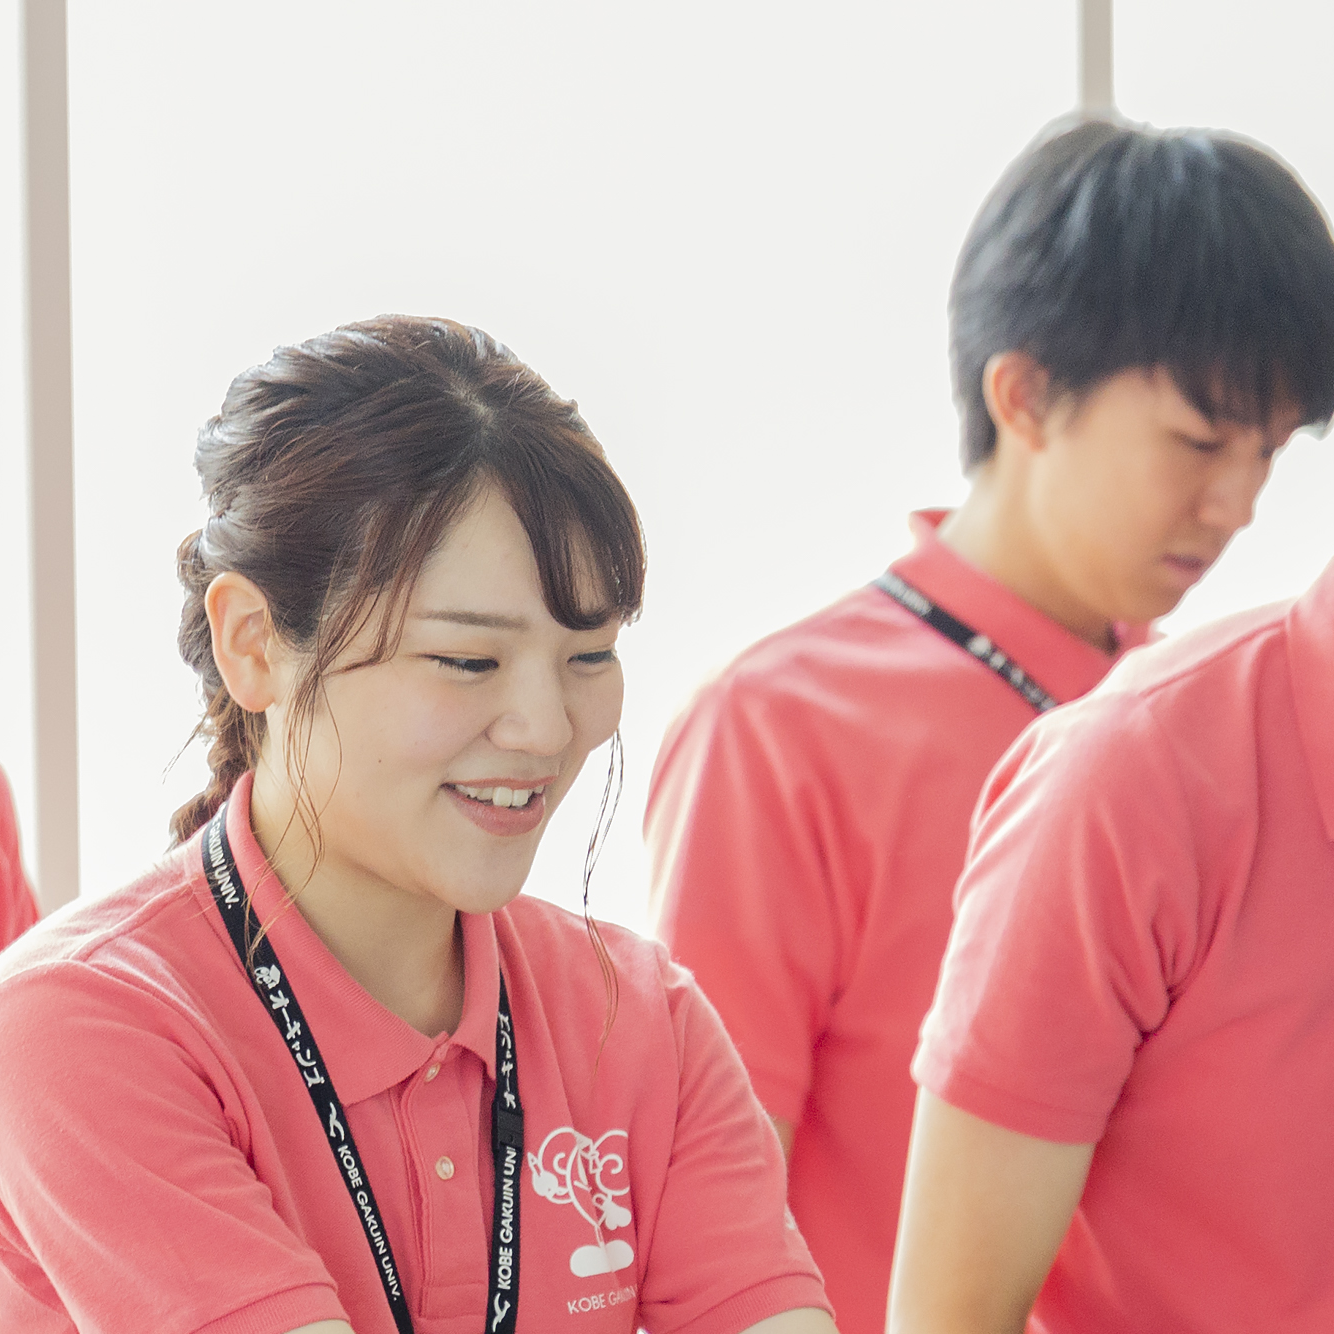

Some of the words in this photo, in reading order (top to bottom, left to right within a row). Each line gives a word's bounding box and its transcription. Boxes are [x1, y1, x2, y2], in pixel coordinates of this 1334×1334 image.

[214, 865, 240, 910] UNIV.
[337, 1145, 363, 1190] KOBE
[356, 1190, 388, 1256] GAKUIN
[381, 1254, 402, 1302] UNIV.
[499, 1180, 515, 1244] GAKUIN
[497, 1246, 513, 1290] KOBE
[567, 1293, 606, 1314] KOBE
